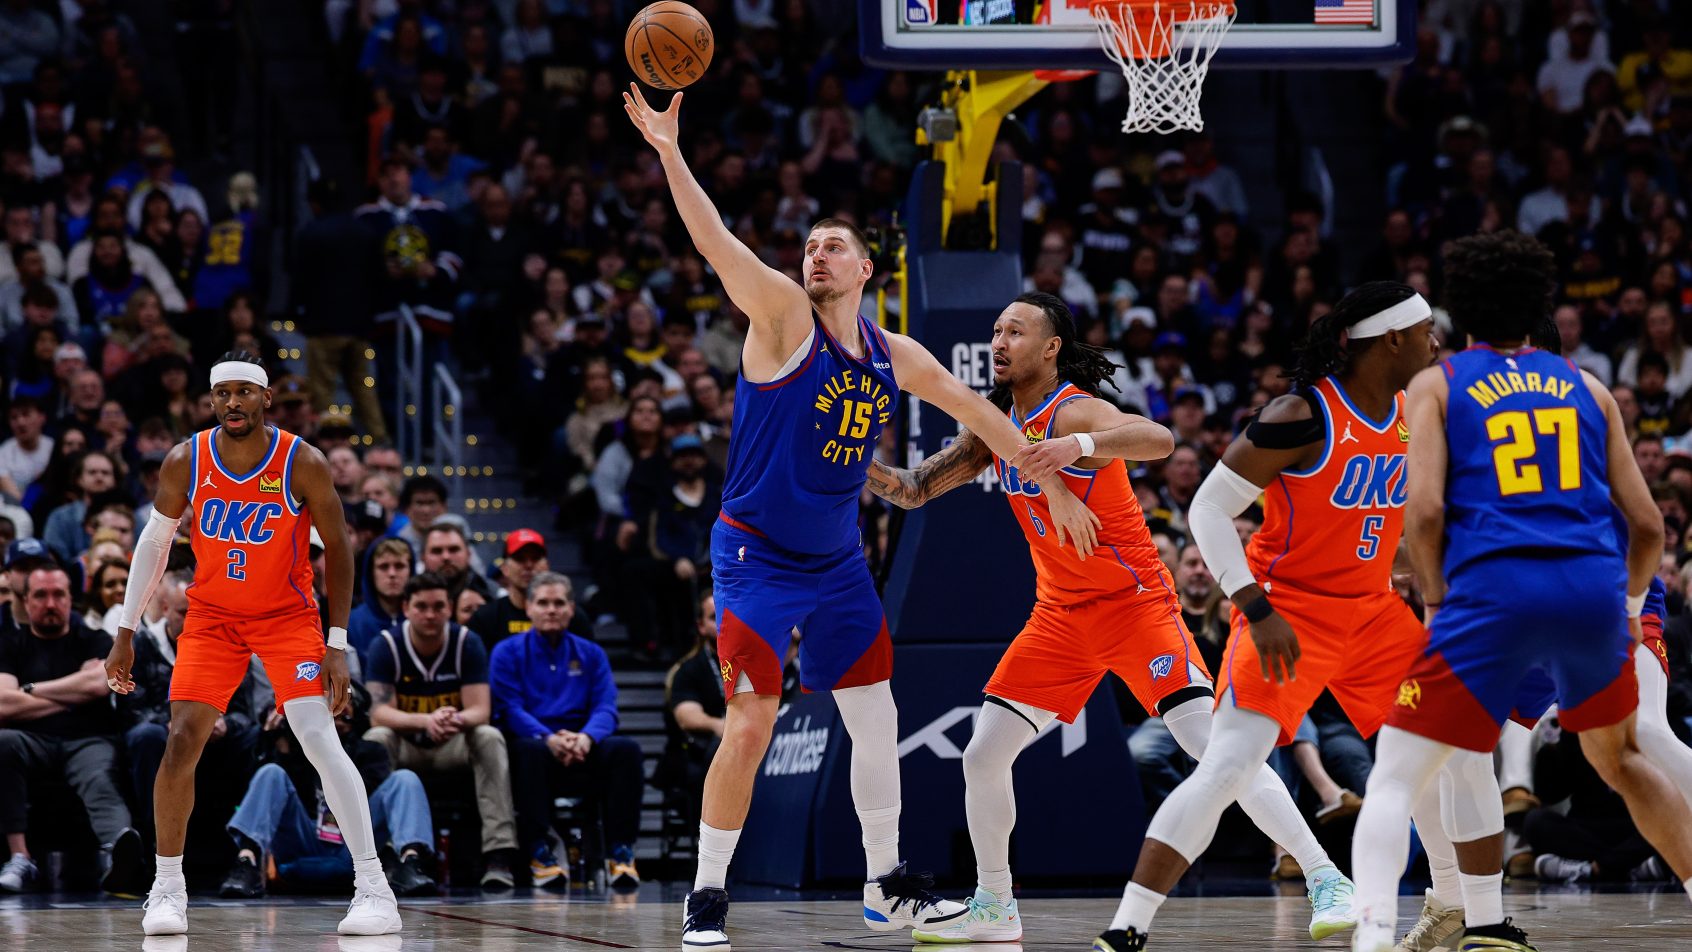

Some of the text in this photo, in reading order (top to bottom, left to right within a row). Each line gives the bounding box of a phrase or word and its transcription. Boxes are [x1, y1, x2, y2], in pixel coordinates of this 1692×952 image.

[815, 369, 890, 424] MILE HIGH
[1466, 372, 1575, 409] MURRAY
[839, 400, 873, 439] 15
[822, 440, 864, 466] CITY
[1485, 407, 1581, 496] 27
[200, 497, 283, 545] OKC
[1025, 500, 1046, 537] 6
[1356, 515, 1385, 561] 5
[227, 548, 247, 581] 2
[765, 714, 829, 776] coinbase
